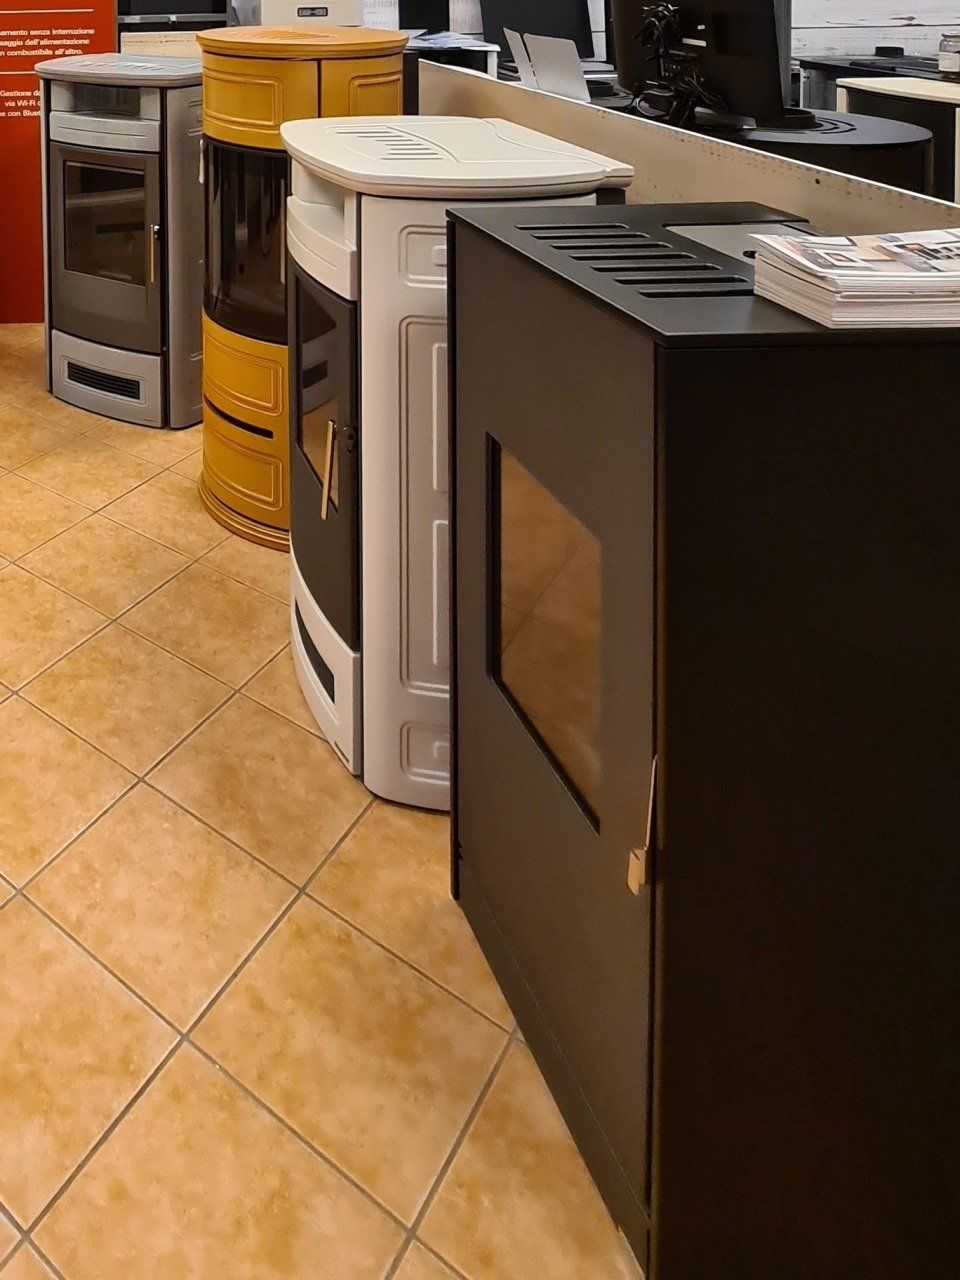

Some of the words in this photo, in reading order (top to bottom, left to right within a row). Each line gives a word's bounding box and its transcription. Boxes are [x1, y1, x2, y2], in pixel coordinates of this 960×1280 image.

[30, 28, 51, 36] senza
[52, 27, 95, 35] interruzione
[6, 48, 54, 57] combustibile
[0, 89, 32, 97] Gestione
